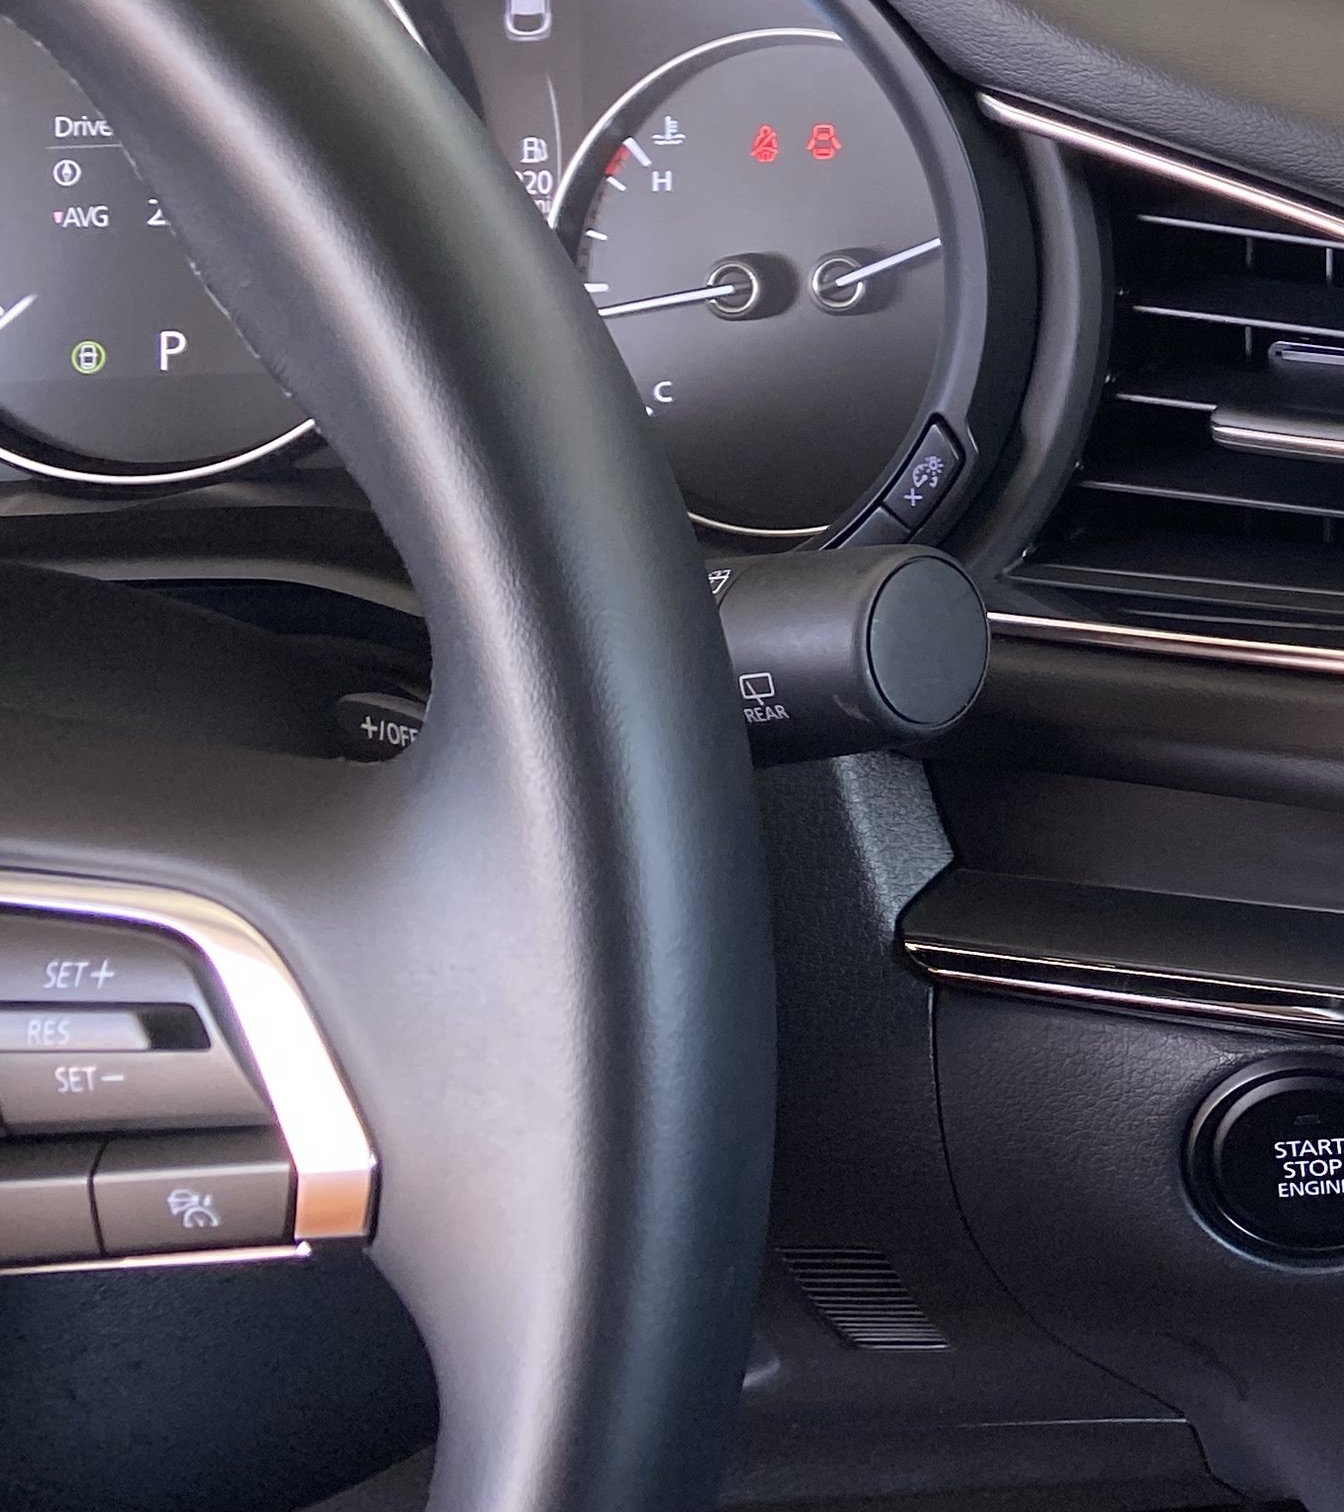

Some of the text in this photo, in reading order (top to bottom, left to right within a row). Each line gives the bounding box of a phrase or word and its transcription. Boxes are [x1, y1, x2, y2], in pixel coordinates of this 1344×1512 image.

[54, 115, 114, 138] Drive
[515, 170, 553, 195] 20
[651, 172, 672, 191] H
[62, 205, 110, 228] AVG
[160, 330, 187, 371] P
[654, 380, 673, 402] C
[743, 704, 790, 723] REAR
[27, 1017, 71, 1046] RES
[1273, 1137, 1344, 1159] START
[1283, 1157, 1343, 1178] STOP
